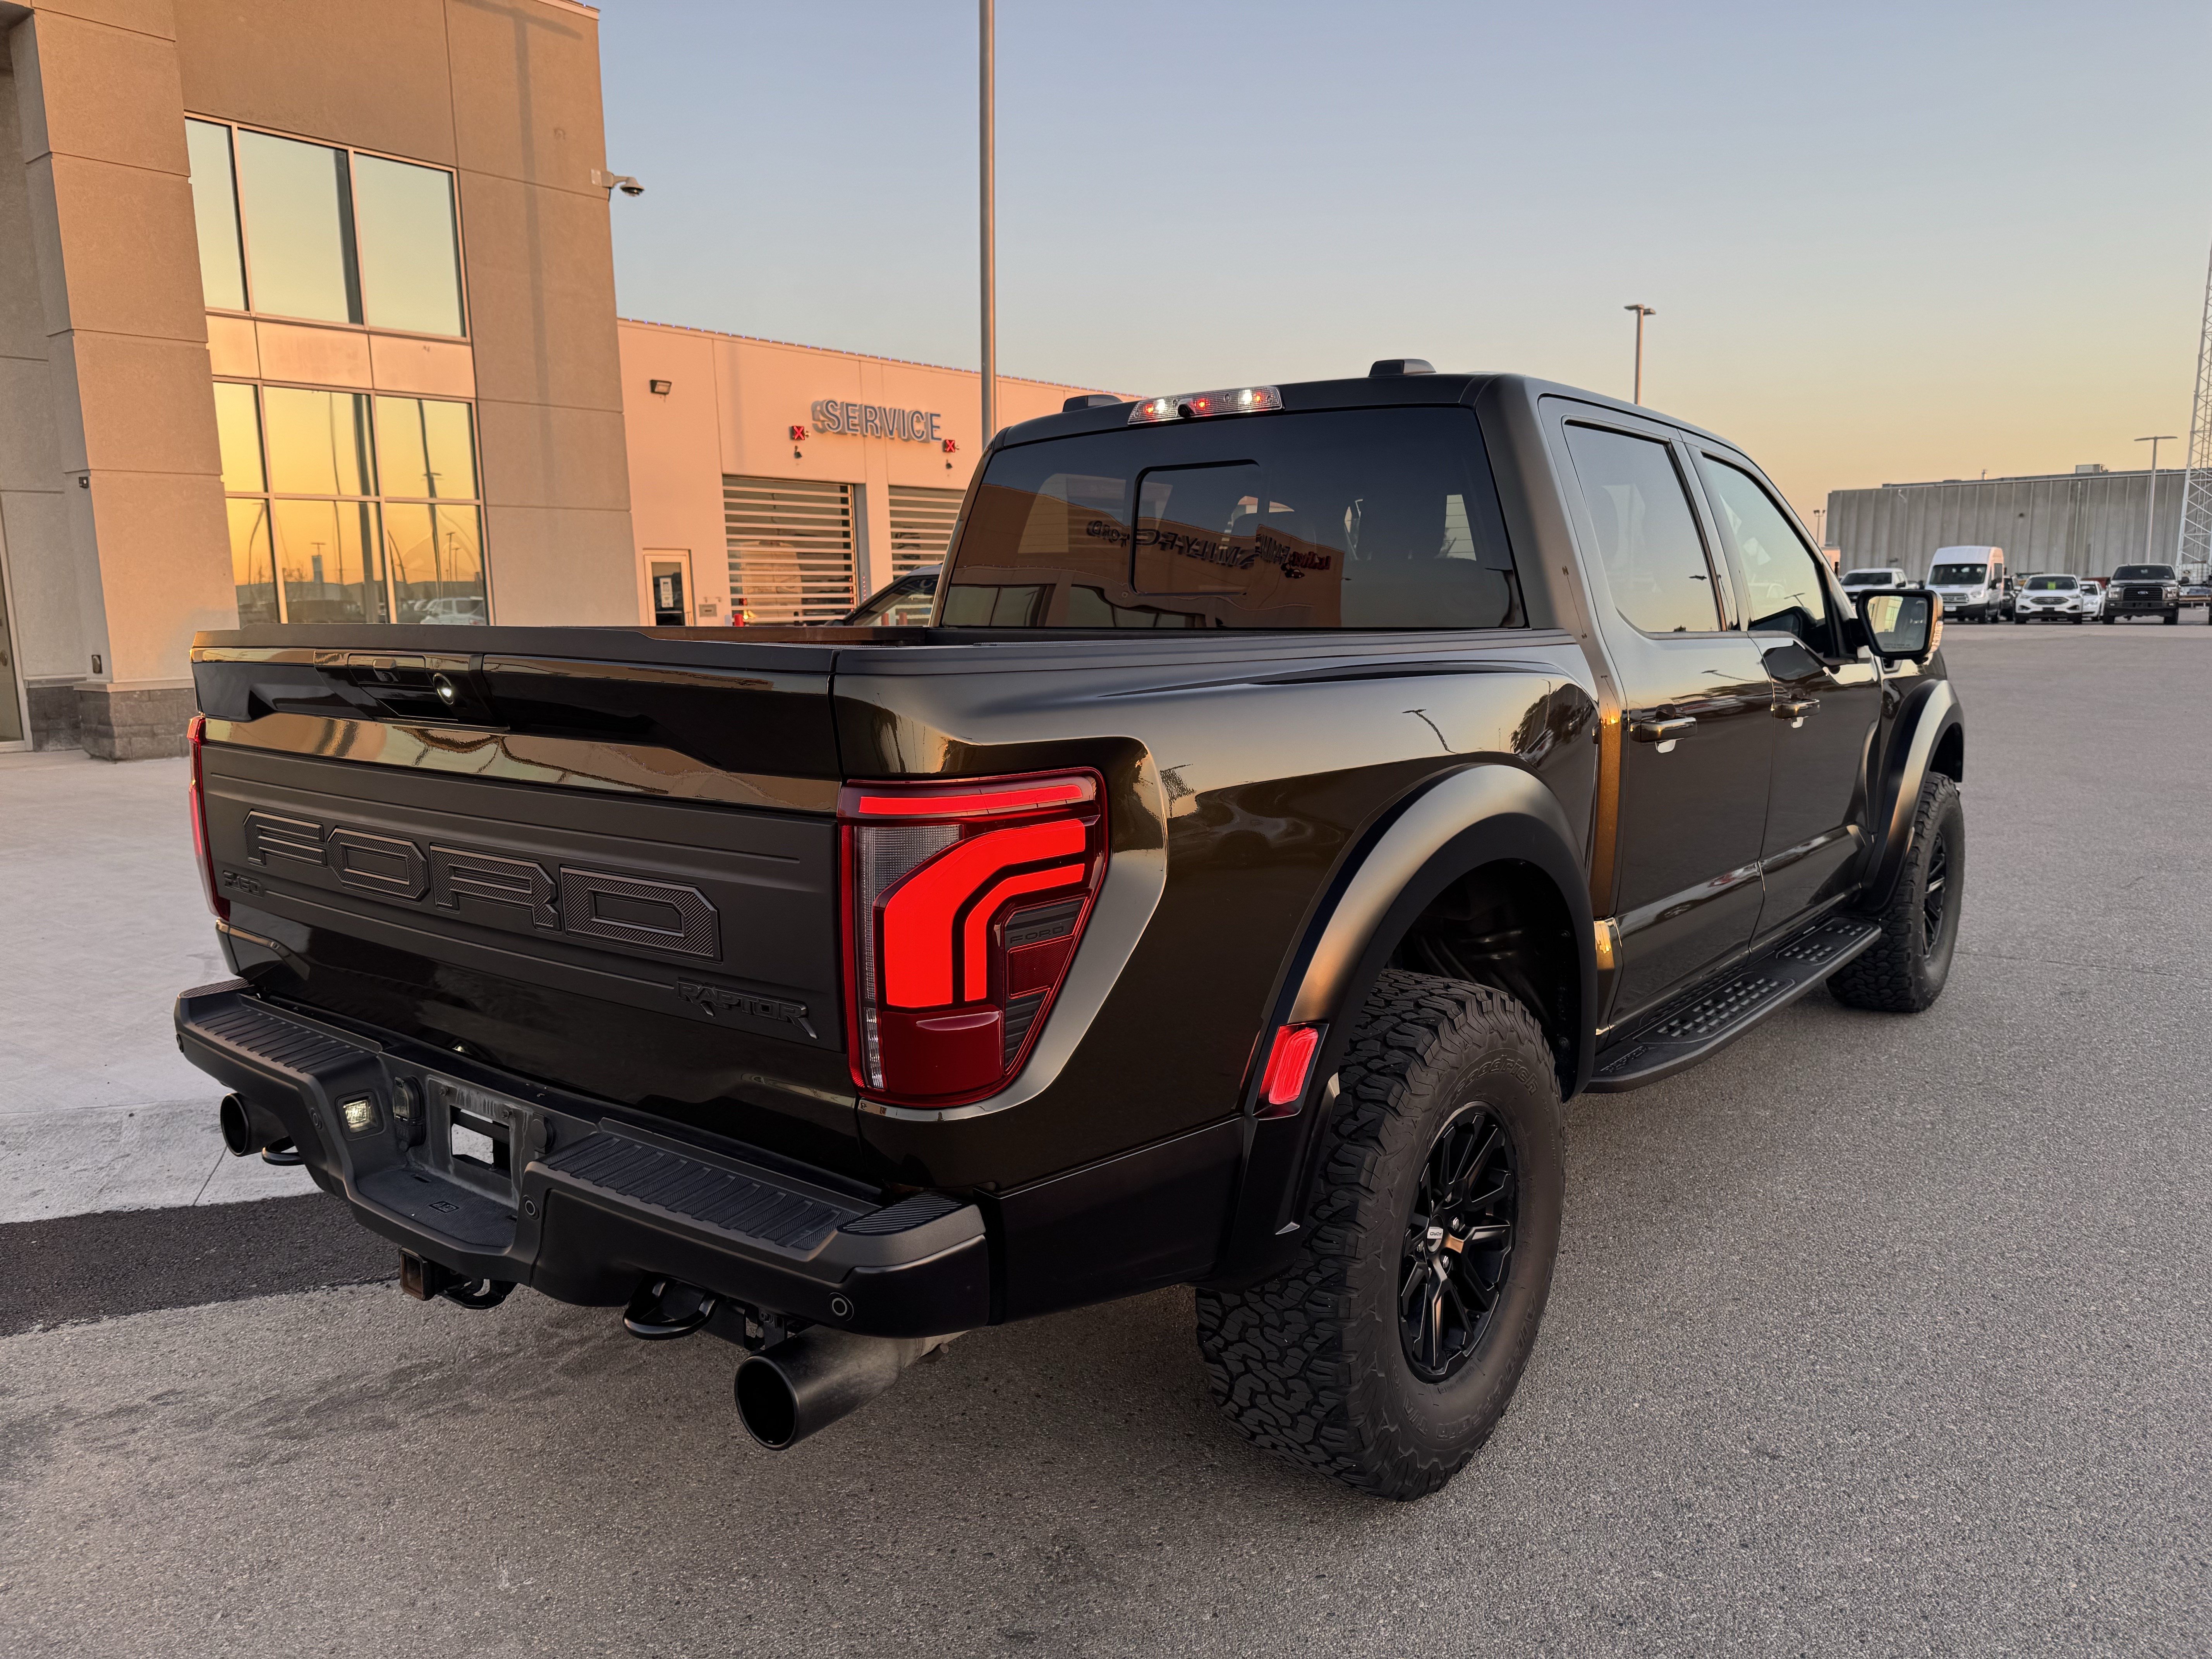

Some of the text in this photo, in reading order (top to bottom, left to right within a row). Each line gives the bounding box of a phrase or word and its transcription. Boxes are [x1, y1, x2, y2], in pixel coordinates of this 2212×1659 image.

[821, 399, 942, 442] SERVICE
[243, 809, 723, 964] FORD
[1010, 926, 1064, 943] FORD
[677, 977, 819, 1039] RAPTOR
